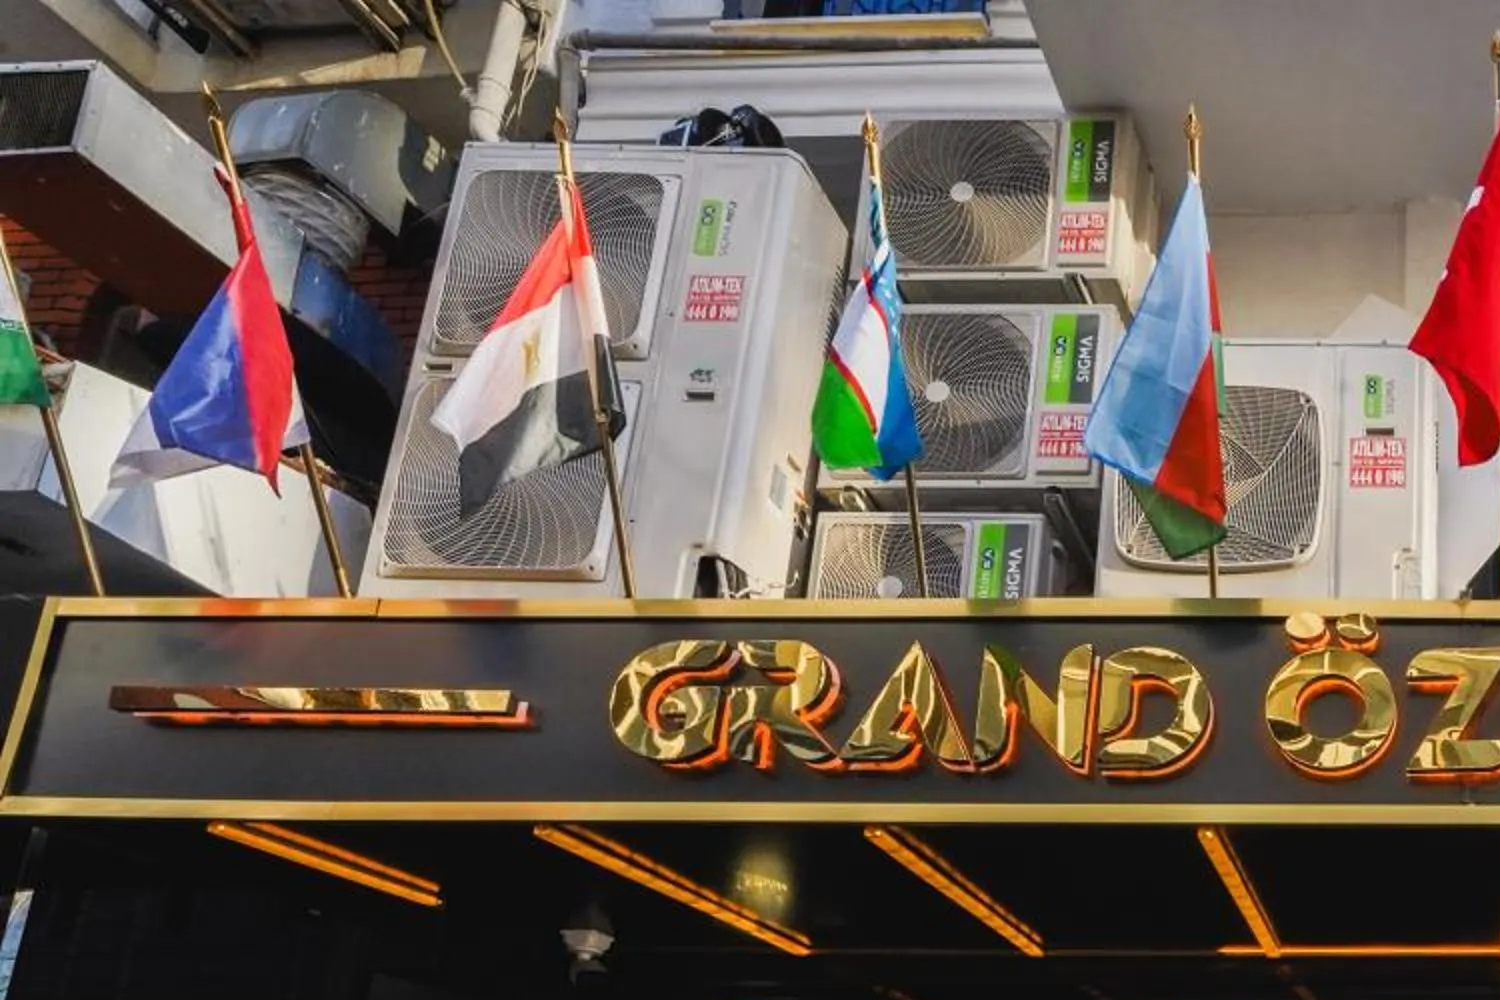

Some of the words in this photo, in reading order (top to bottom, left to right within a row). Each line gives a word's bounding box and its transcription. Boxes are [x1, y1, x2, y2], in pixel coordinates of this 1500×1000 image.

[1094, 141, 1110, 183] SIGMA
[1076, 336, 1093, 383] SIGMA
[1351, 469, 1372, 485] 444
[1005, 548, 1023, 600] SIGMA
[609, 639, 1215, 778] GRAND
